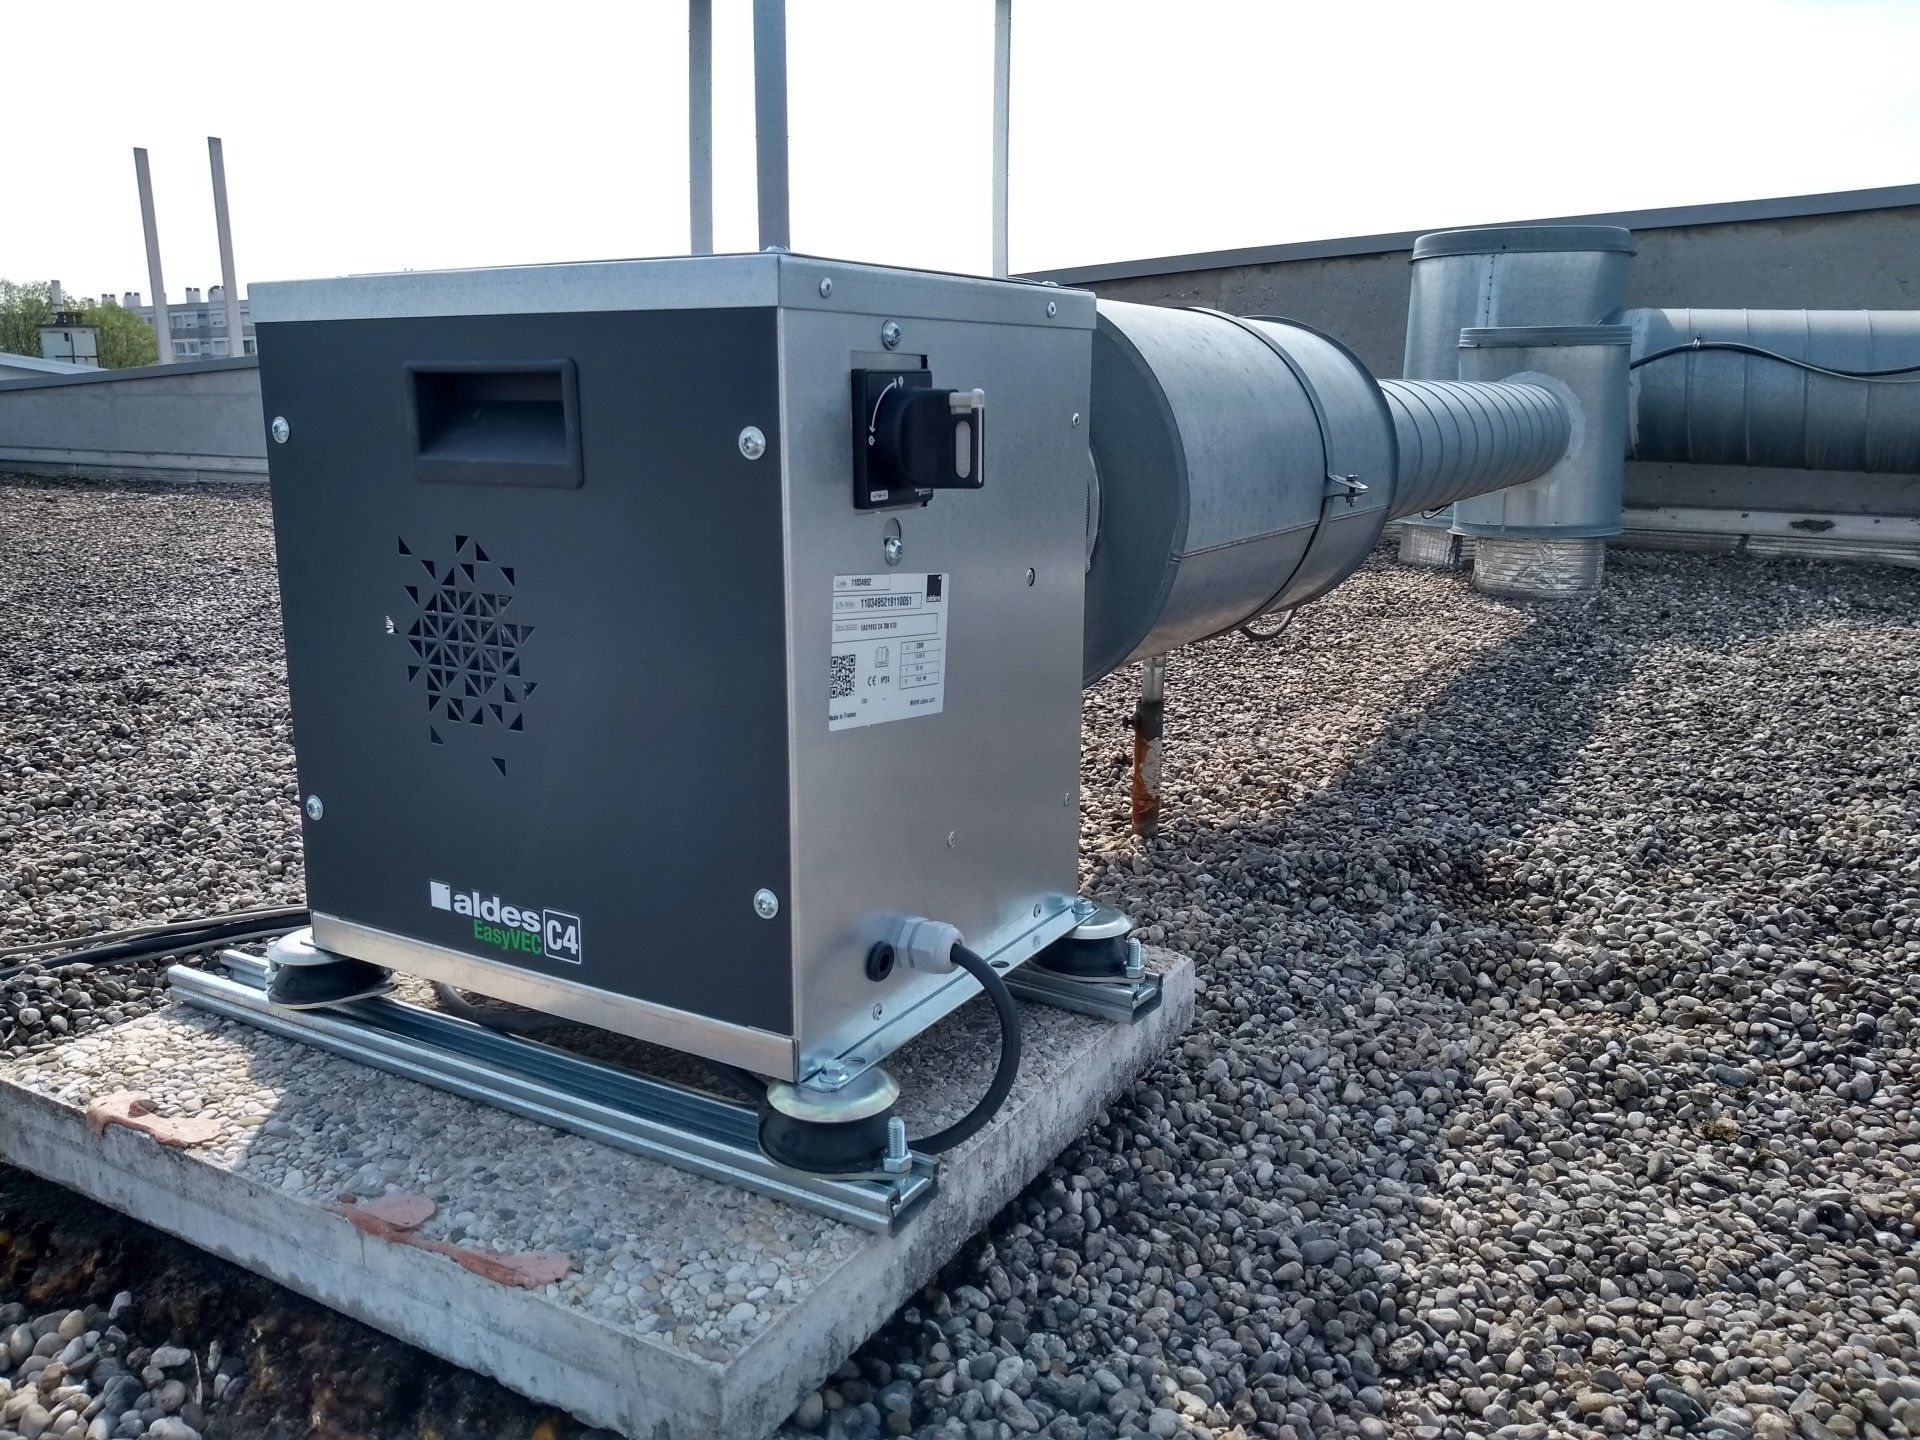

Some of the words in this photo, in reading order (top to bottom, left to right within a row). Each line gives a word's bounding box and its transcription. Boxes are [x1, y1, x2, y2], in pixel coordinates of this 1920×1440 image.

[851, 578, 872, 587] 11034952
[453, 891, 542, 933] aldes
[473, 919, 542, 955] EasyVEC
[546, 919, 578, 955] C4
